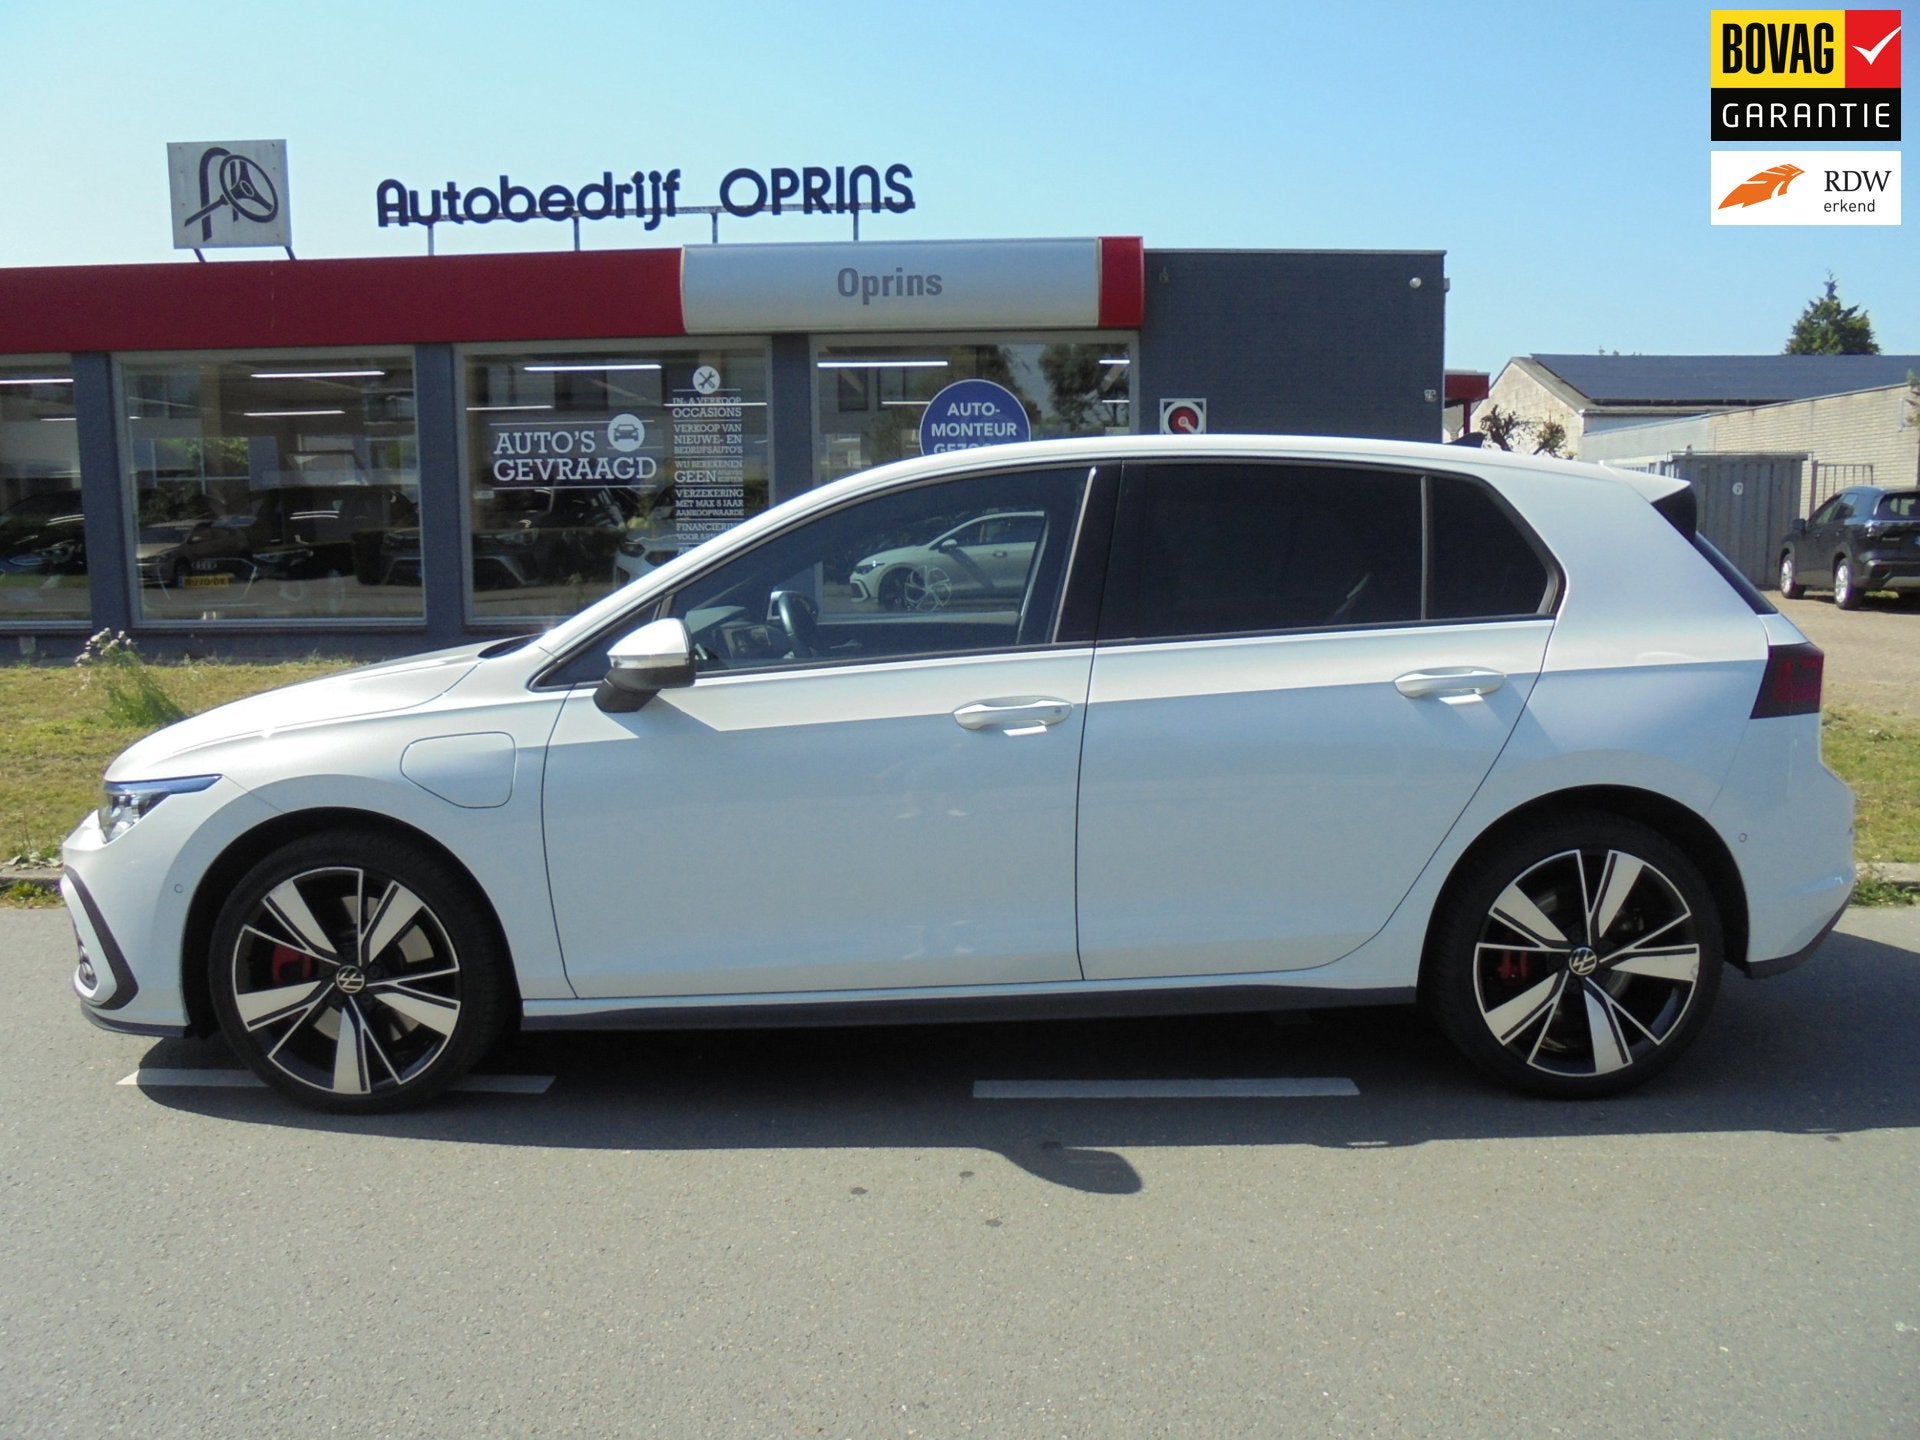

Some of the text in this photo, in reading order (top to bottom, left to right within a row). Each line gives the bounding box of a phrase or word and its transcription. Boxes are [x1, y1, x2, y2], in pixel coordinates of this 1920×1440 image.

[376, 163, 914, 231] Autobedrijf OPRINS
[837, 267, 943, 306] Oprins
[672, 407, 742, 418] OCCASIONS
[946, 402, 1000, 416] AUTO-
[673, 423, 742, 432] VERKOOP VAN
[931, 422, 1017, 437] MONTEUR
[673, 434, 742, 444] NIEUWE- EN
[493, 456, 657, 481] GEVRAAGD
[674, 470, 717, 483] GEEN
[674, 488, 744, 498] VERZEKERING
[675, 500, 694, 508] MET
